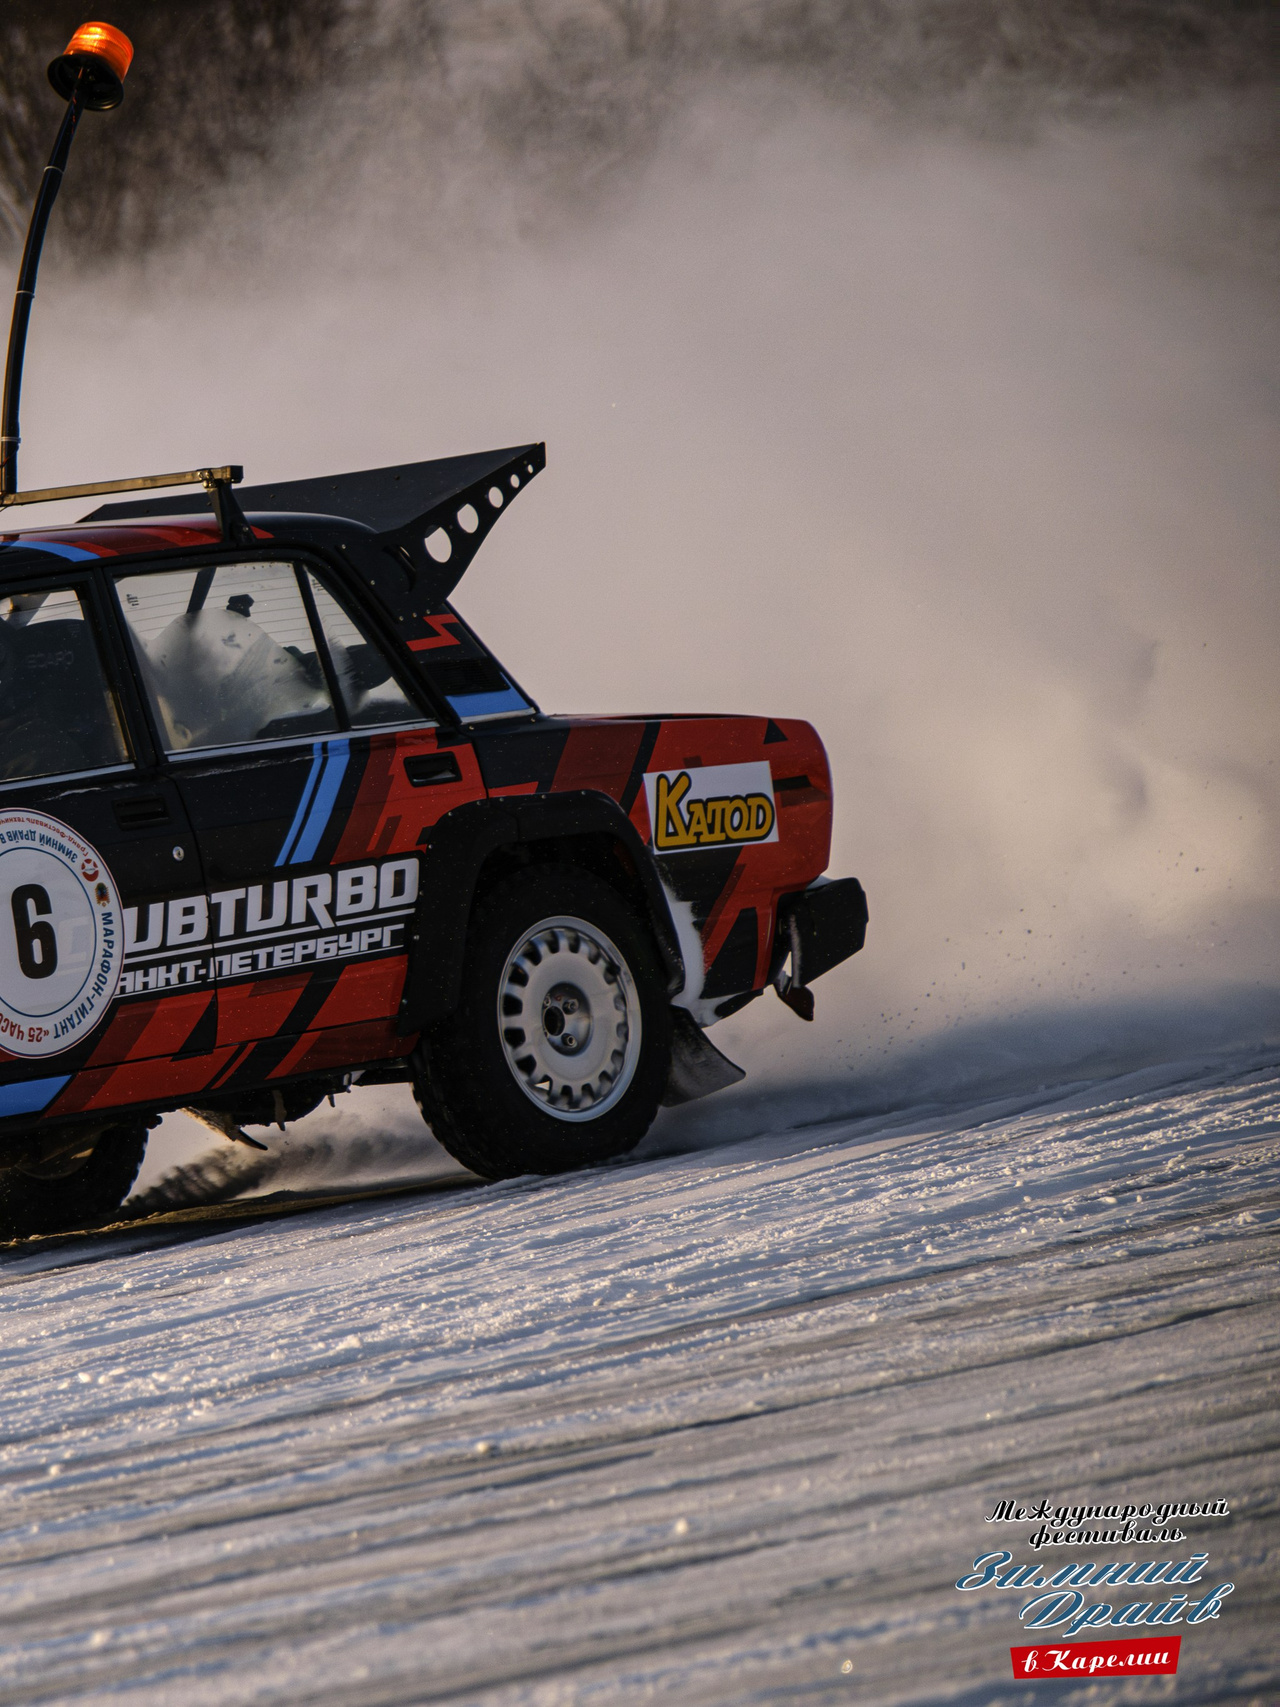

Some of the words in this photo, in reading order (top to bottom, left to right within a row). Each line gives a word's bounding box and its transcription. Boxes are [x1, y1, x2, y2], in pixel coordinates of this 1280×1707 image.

[6, 829, 37, 843] ДРАЙВ
[39, 833, 78, 863] ЗИМНИЙ
[53, 911, 115, 1039] МАРАФОН-ГИГАНТ
